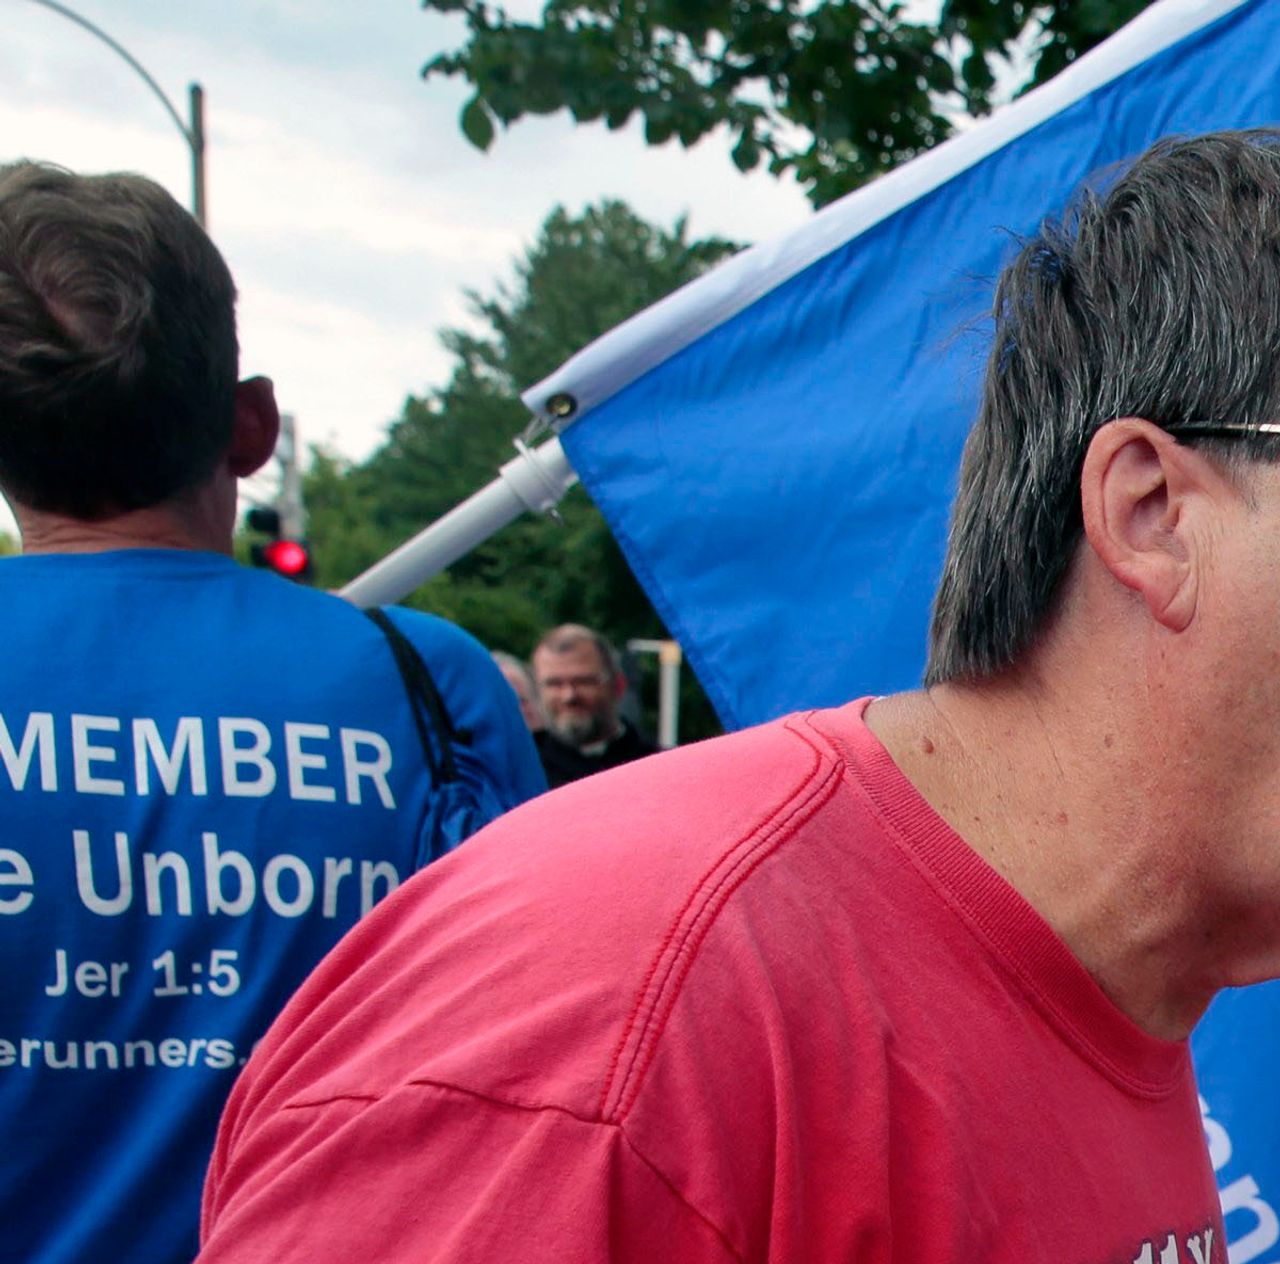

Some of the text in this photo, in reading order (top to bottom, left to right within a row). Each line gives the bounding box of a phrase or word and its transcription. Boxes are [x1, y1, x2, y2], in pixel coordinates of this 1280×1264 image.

[73, 829, 399, 918] Unborn
[45, 949, 241, 996] Jer 1:5
